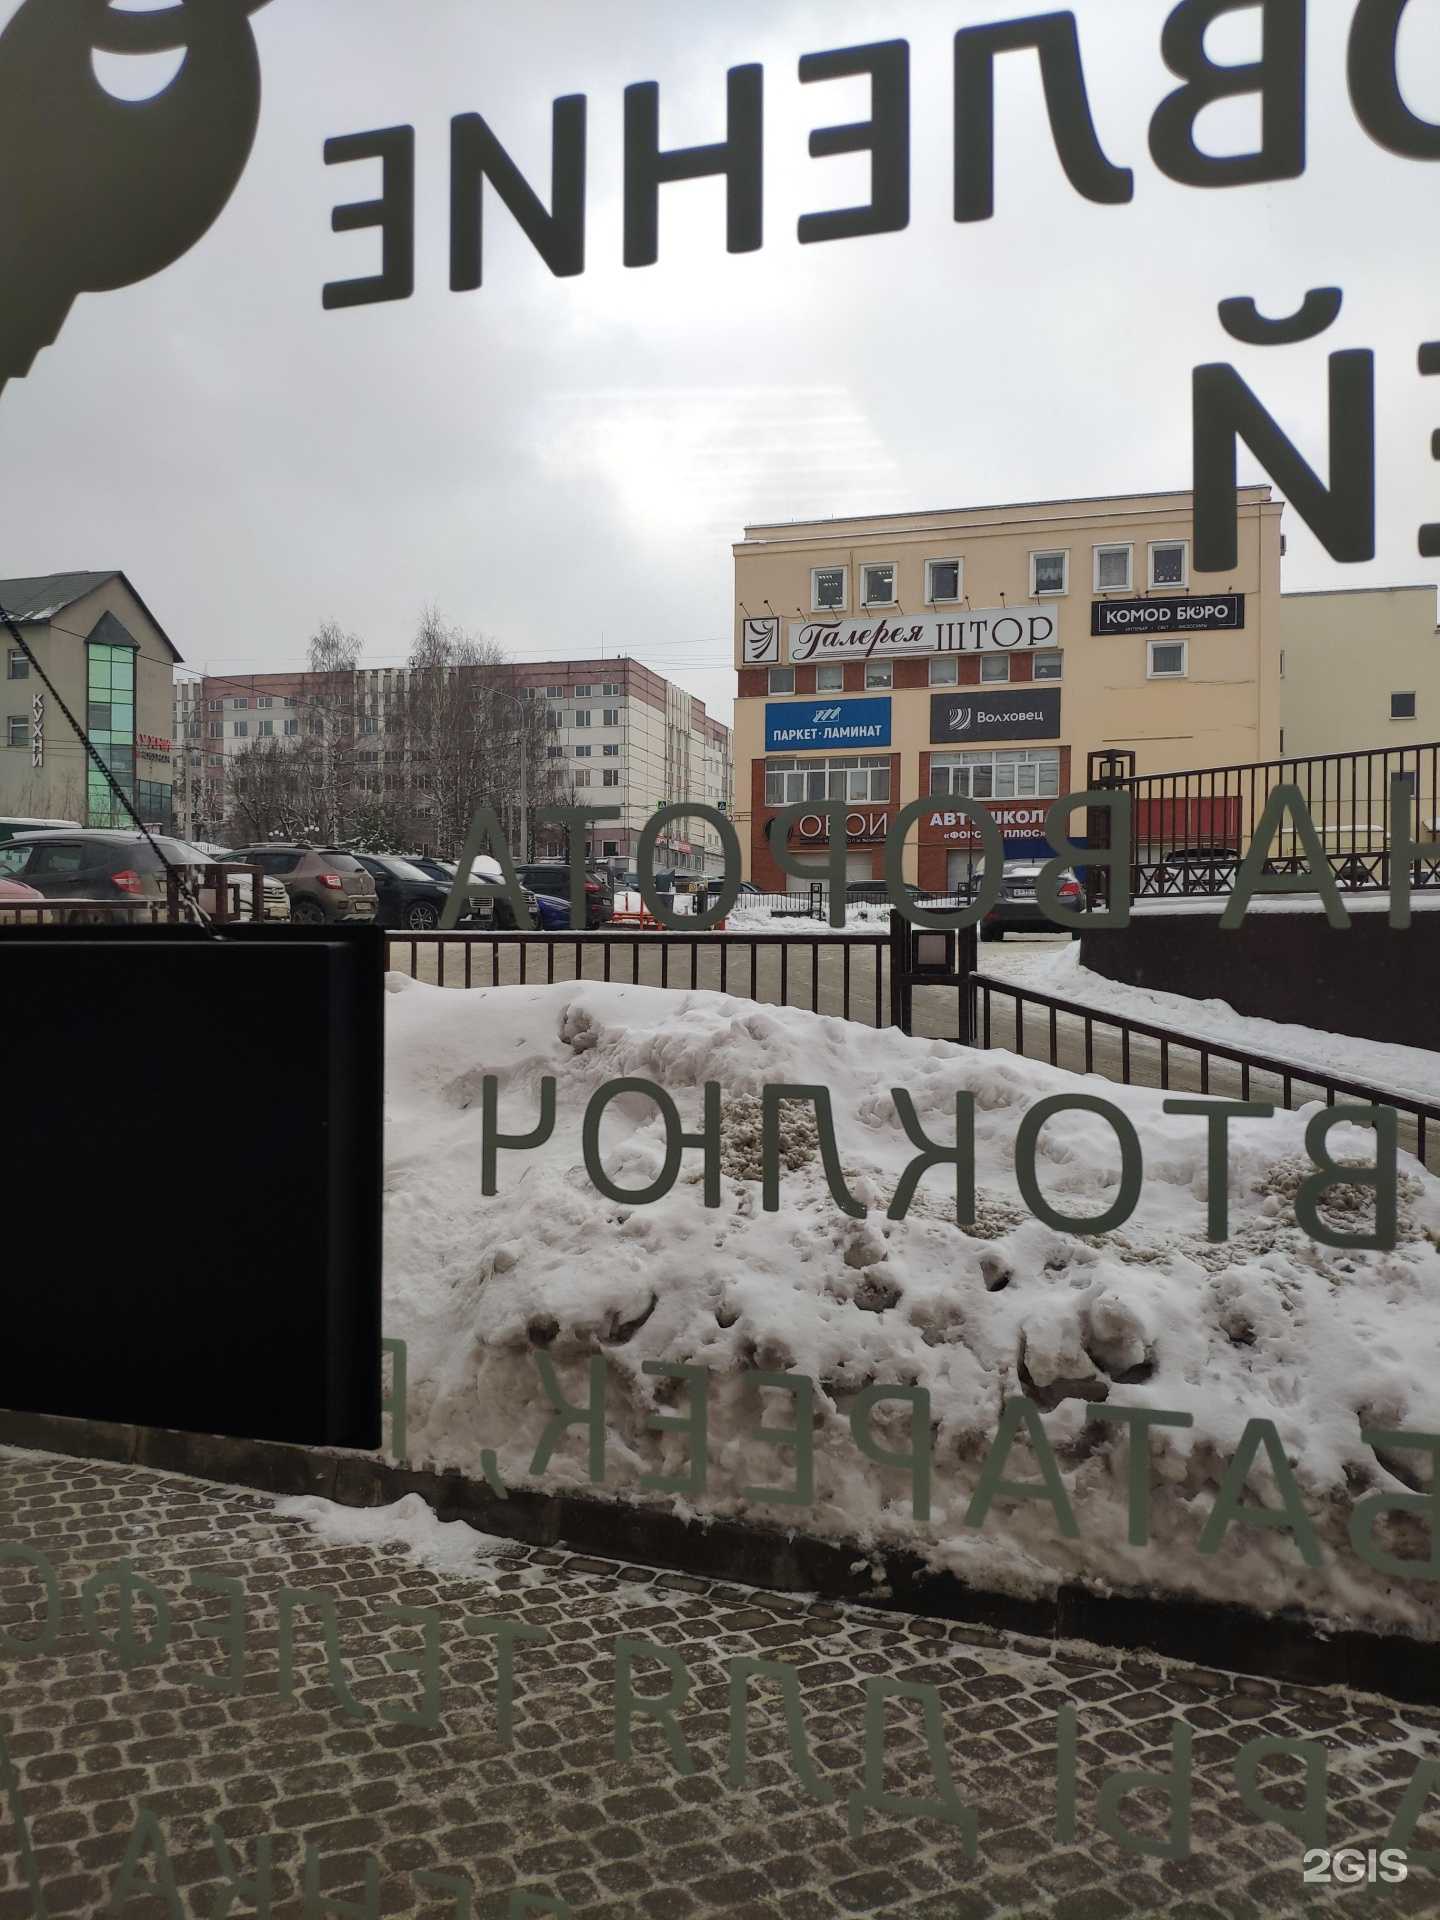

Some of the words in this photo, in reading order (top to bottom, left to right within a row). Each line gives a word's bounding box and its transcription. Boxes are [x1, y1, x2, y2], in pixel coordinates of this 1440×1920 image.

[1176, 604, 1229, 621] БЮРО
[791, 619, 925, 661] Галерея
[935, 615, 1054, 652] ШТОР
[976, 710, 1044, 724] Волховец
[32, 693, 44, 768] КУХНИ
[929, 809, 1048, 828] АВТШКОЛ
